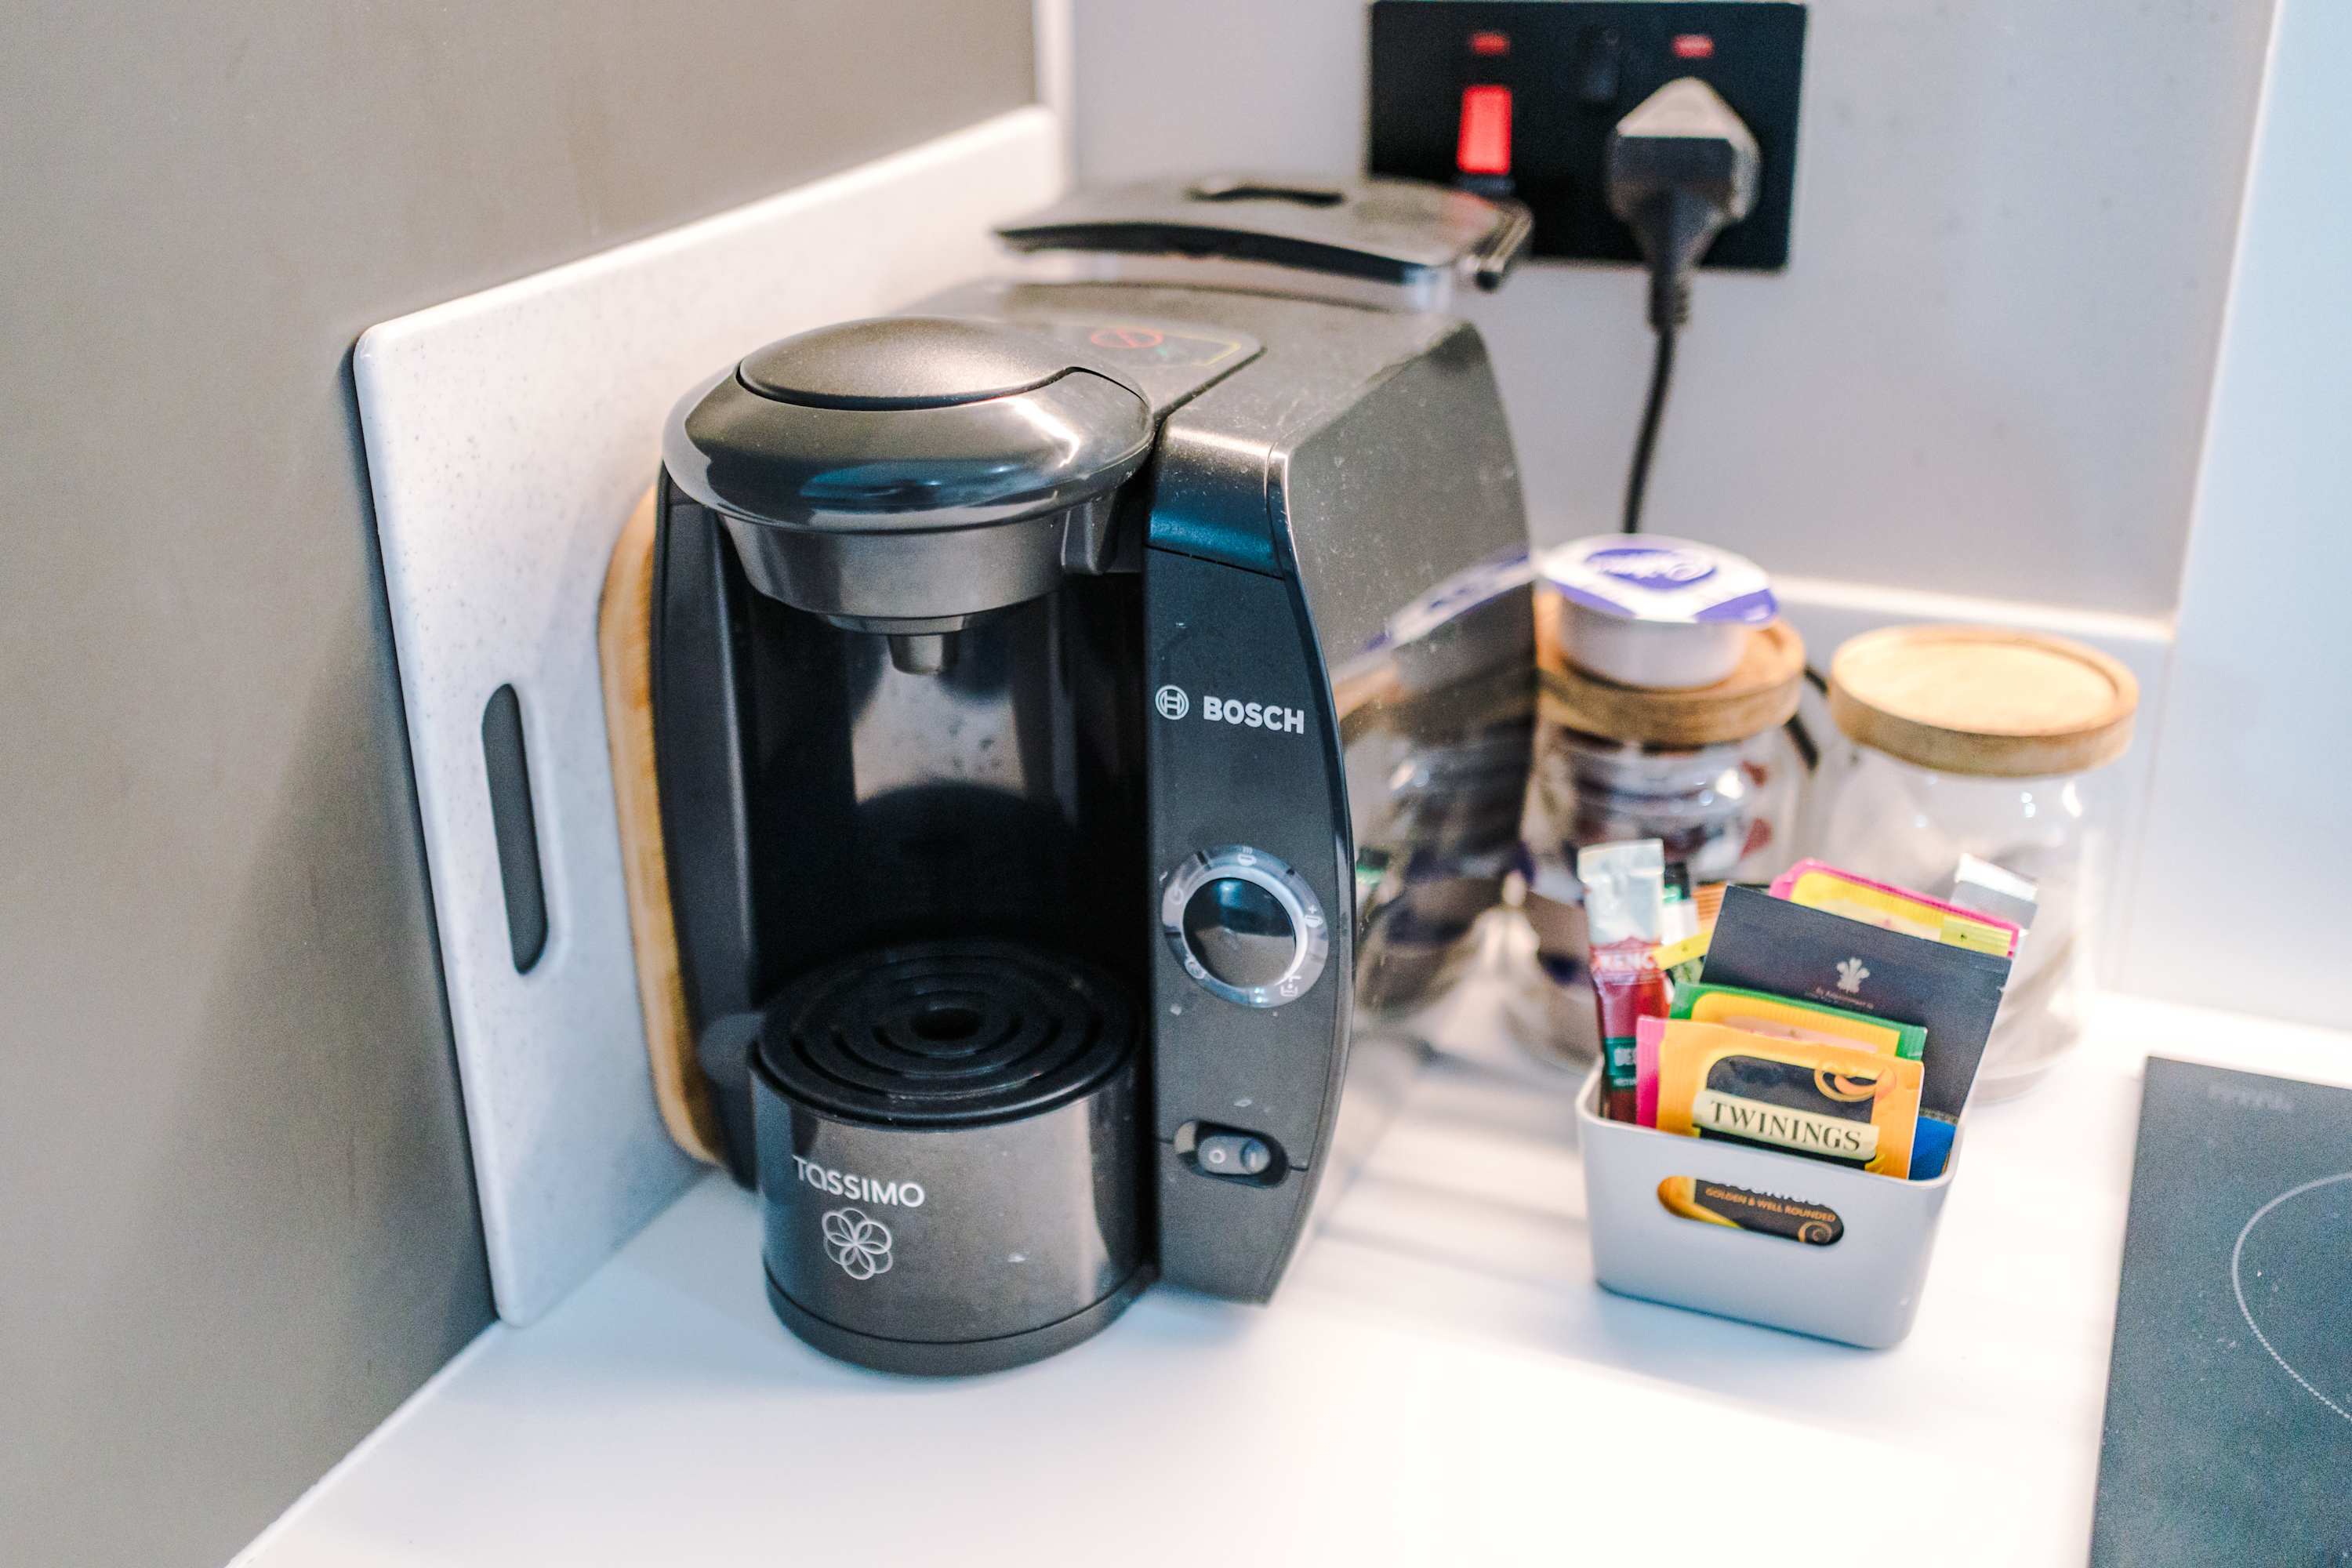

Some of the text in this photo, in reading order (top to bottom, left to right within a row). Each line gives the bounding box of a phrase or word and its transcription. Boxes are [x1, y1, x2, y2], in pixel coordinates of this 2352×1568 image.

[1203, 695, 1305, 735] BOSCH
[1599, 951, 1657, 971] KENC
[1711, 1100, 1860, 1152] TWININGS
[1705, 1186, 1747, 1205] GOLDEN
[1757, 1198, 1783, 1214] WELL
[1784, 1205, 1836, 1223] ROUNDED
